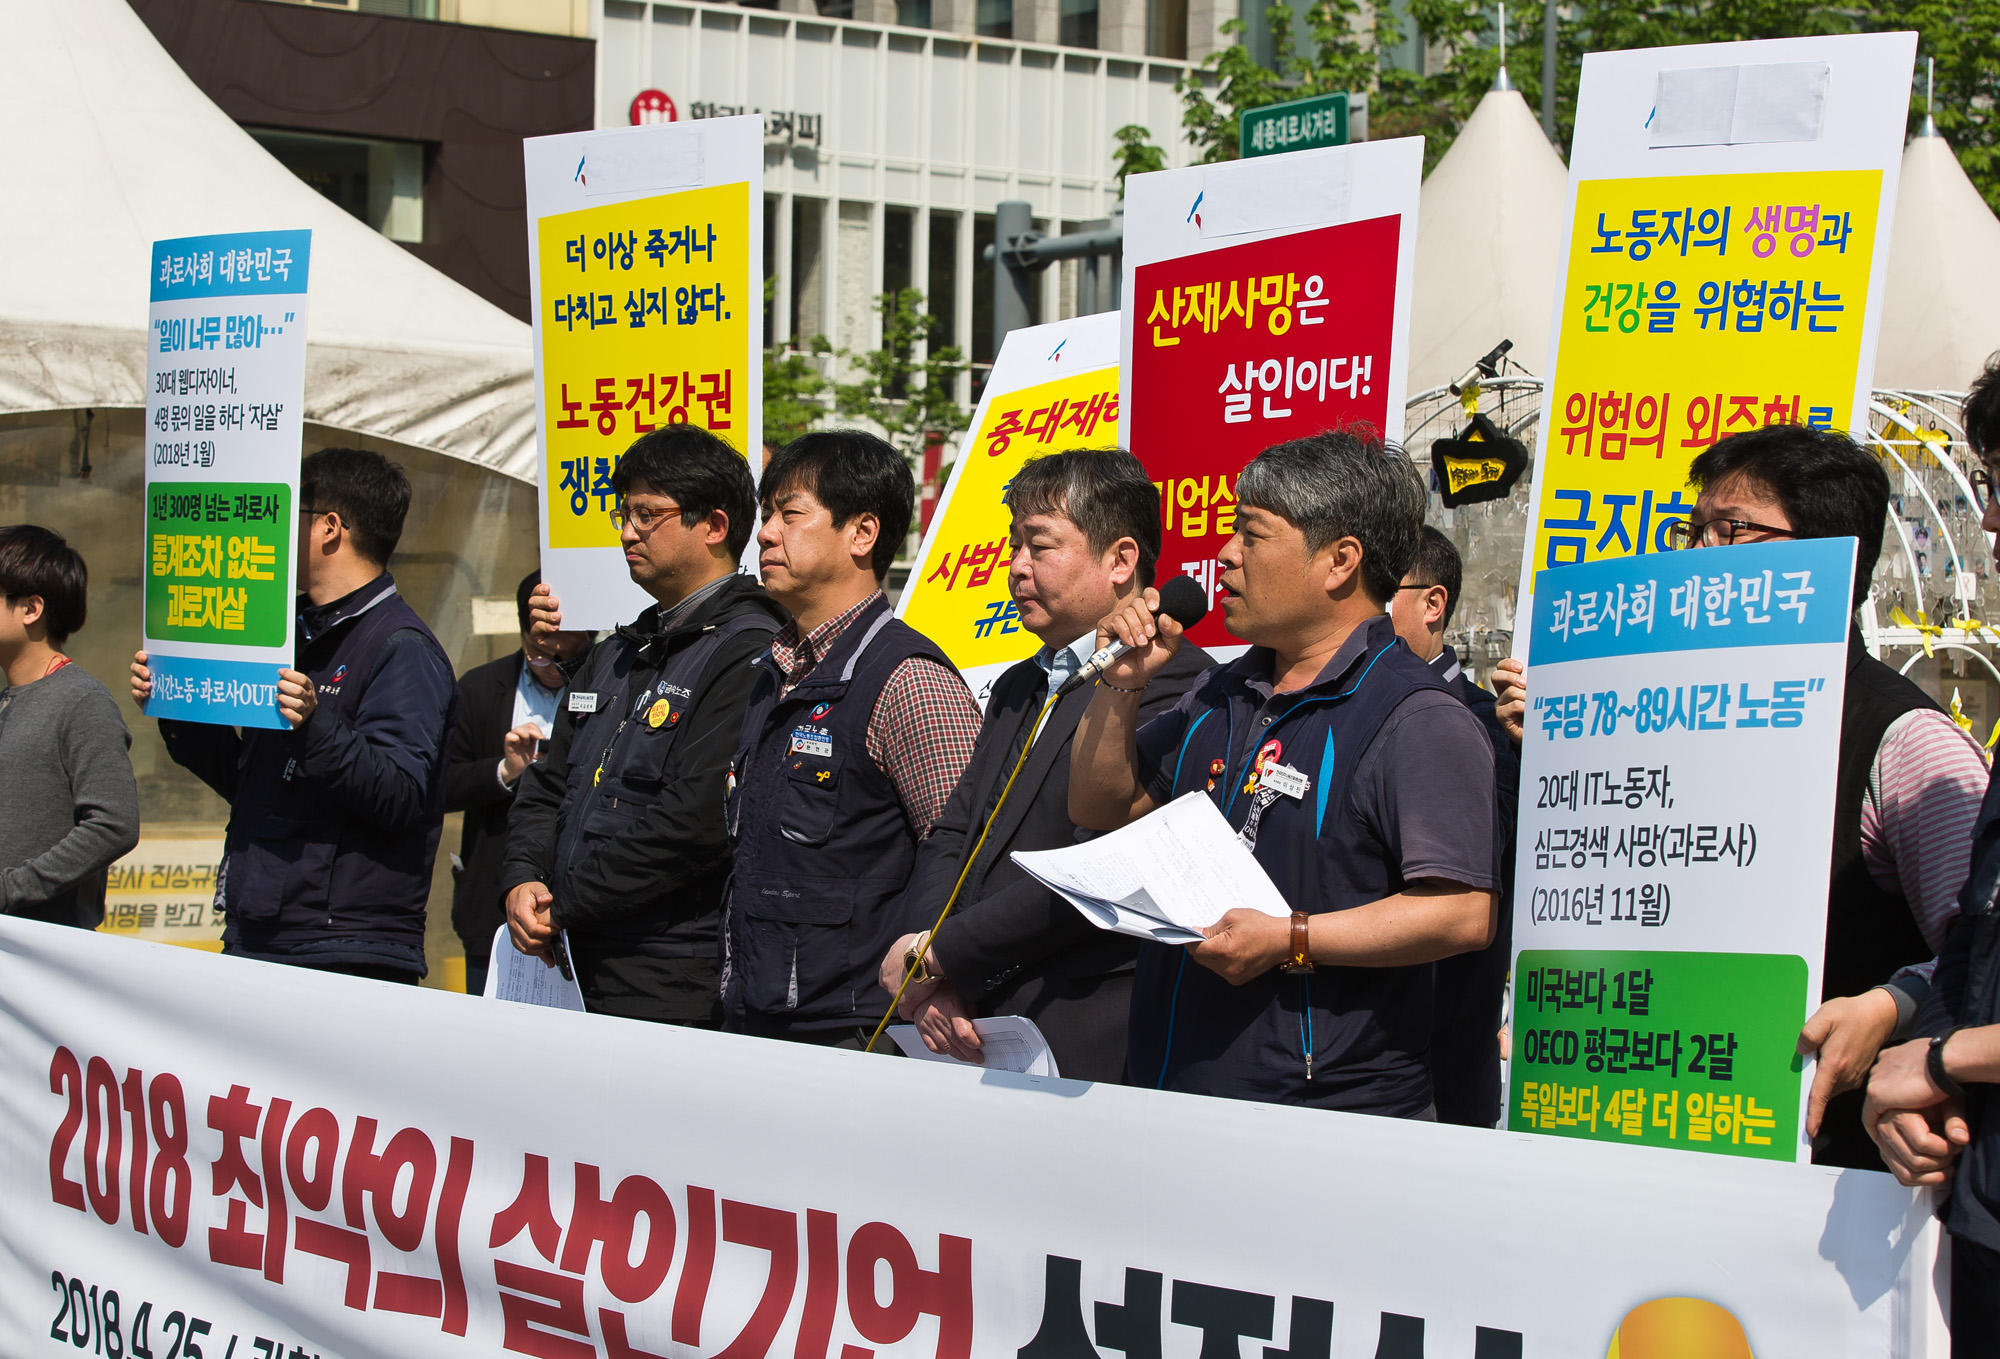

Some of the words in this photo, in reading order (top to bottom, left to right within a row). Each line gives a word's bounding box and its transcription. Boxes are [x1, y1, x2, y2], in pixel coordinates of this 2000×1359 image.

[1250, 106, 1336, 152] 세종대로사거리
[566, 234, 586, 273] 더
[593, 229, 638, 271] 이상
[644, 223, 717, 269] 죽거나
[1590, 206, 1732, 262] 노동자의
[1743, 203, 1853, 259] 생명과
[159, 250, 214, 289] 과로사회
[219, 246, 293, 284] 대한민국
[554, 291, 618, 332] 다치고
[624, 286, 667, 329] 싶지
[675, 282, 731, 326] 않다.
[1146, 272, 1330, 348] 산재사망은
[1583, 280, 1681, 334] 건강을
[1693, 278, 1845, 333] 위협하는
[154, 318, 186, 353] “일이
[190, 316, 221, 351] 너무
[155, 368, 177, 396] 30대
[178, 366, 238, 396] 웹디자이너,
[556, 368, 732, 437] 노동건강권
[1218, 355, 1373, 424] 살인이다!
[154, 404, 169, 432] 4명
[194, 403, 216, 431] 일을
[219, 402, 245, 431] 하다
[249, 402, 284, 431] ‘자살’
[1560, 390, 1671, 461] 위험의
[154, 440, 190, 468] (2018년
[193, 440, 216, 468] 1월)
[153, 493, 168, 522] 1년
[170, 493, 202, 522] 300명
[205, 493, 231, 523] 넘는
[233, 493, 280, 524] 과로사
[152, 533, 224, 579] 통계조차
[227, 536, 276, 581] 없는
[927, 536, 1013, 592] 사법
[167, 584, 248, 631] 과로자살
[1549, 579, 1657, 643] 과로사회
[1669, 569, 1816, 631] 대한민국
[1533, 693, 1587, 741] “주당
[1590, 683, 1732, 737] 78~89시간
[1735, 677, 1826, 729] 노동”
[1536, 769, 1580, 812] 20대
[1583, 764, 1675, 810] IT노동자,
[1534, 825, 1610, 870] 심근경색
[1613, 822, 1758, 868] 사망(과로사)
[163, 902, 205, 928] 받고
[1531, 883, 1605, 927] (2016년
[1610, 882, 1671, 927] 11월)
[1526, 966, 1608, 1014] 미국보다
[1611, 968, 1654, 1016] 1달
[1523, 1028, 1579, 1066] OECD
[1584, 1026, 1683, 1078] 평균보다
[1687, 1032, 1739, 1081] 2달
[1520, 1081, 1601, 1133] 독일보다
[1603, 1087, 1647, 1137] 4달
[1652, 1089, 1679, 1140] 더
[1686, 1092, 1776, 1146] 일하는
[49, 1045, 193, 1249] 2018
[206, 1083, 475, 1338] 최악의
[488, 1152, 974, 1359] 살인기업
